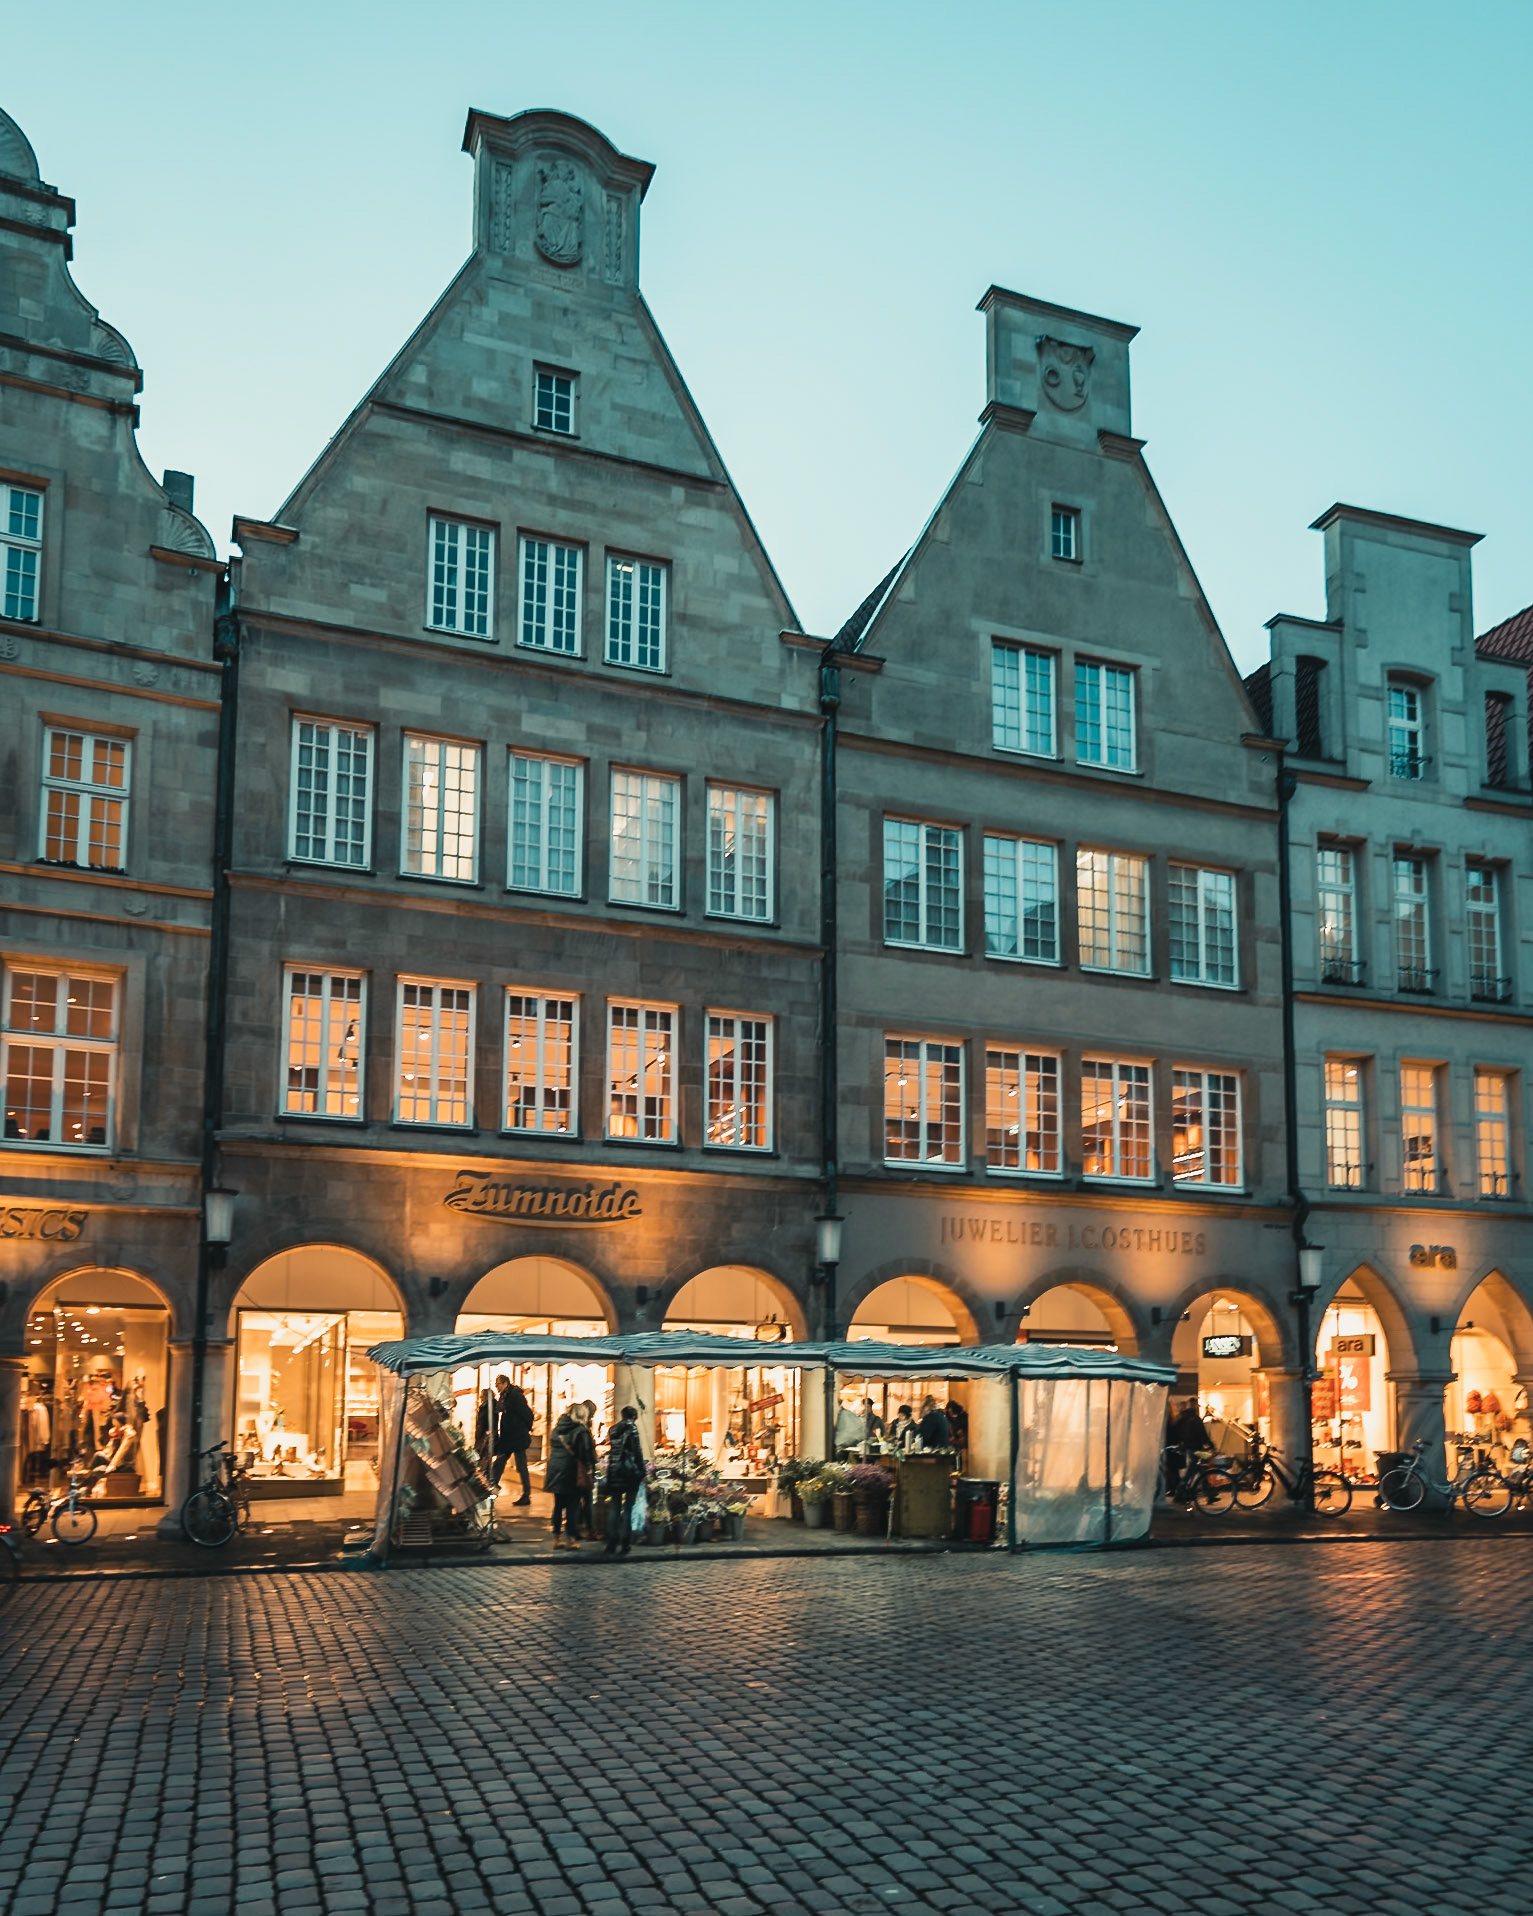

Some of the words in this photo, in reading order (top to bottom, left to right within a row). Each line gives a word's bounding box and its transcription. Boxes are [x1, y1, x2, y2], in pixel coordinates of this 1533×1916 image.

[0, 1206, 88, 1241] SICS
[940, 1216, 1060, 1248] JUWELIER
[1409, 1244, 1457, 1270] ara
[1337, 1339, 1364, 1352] ara
